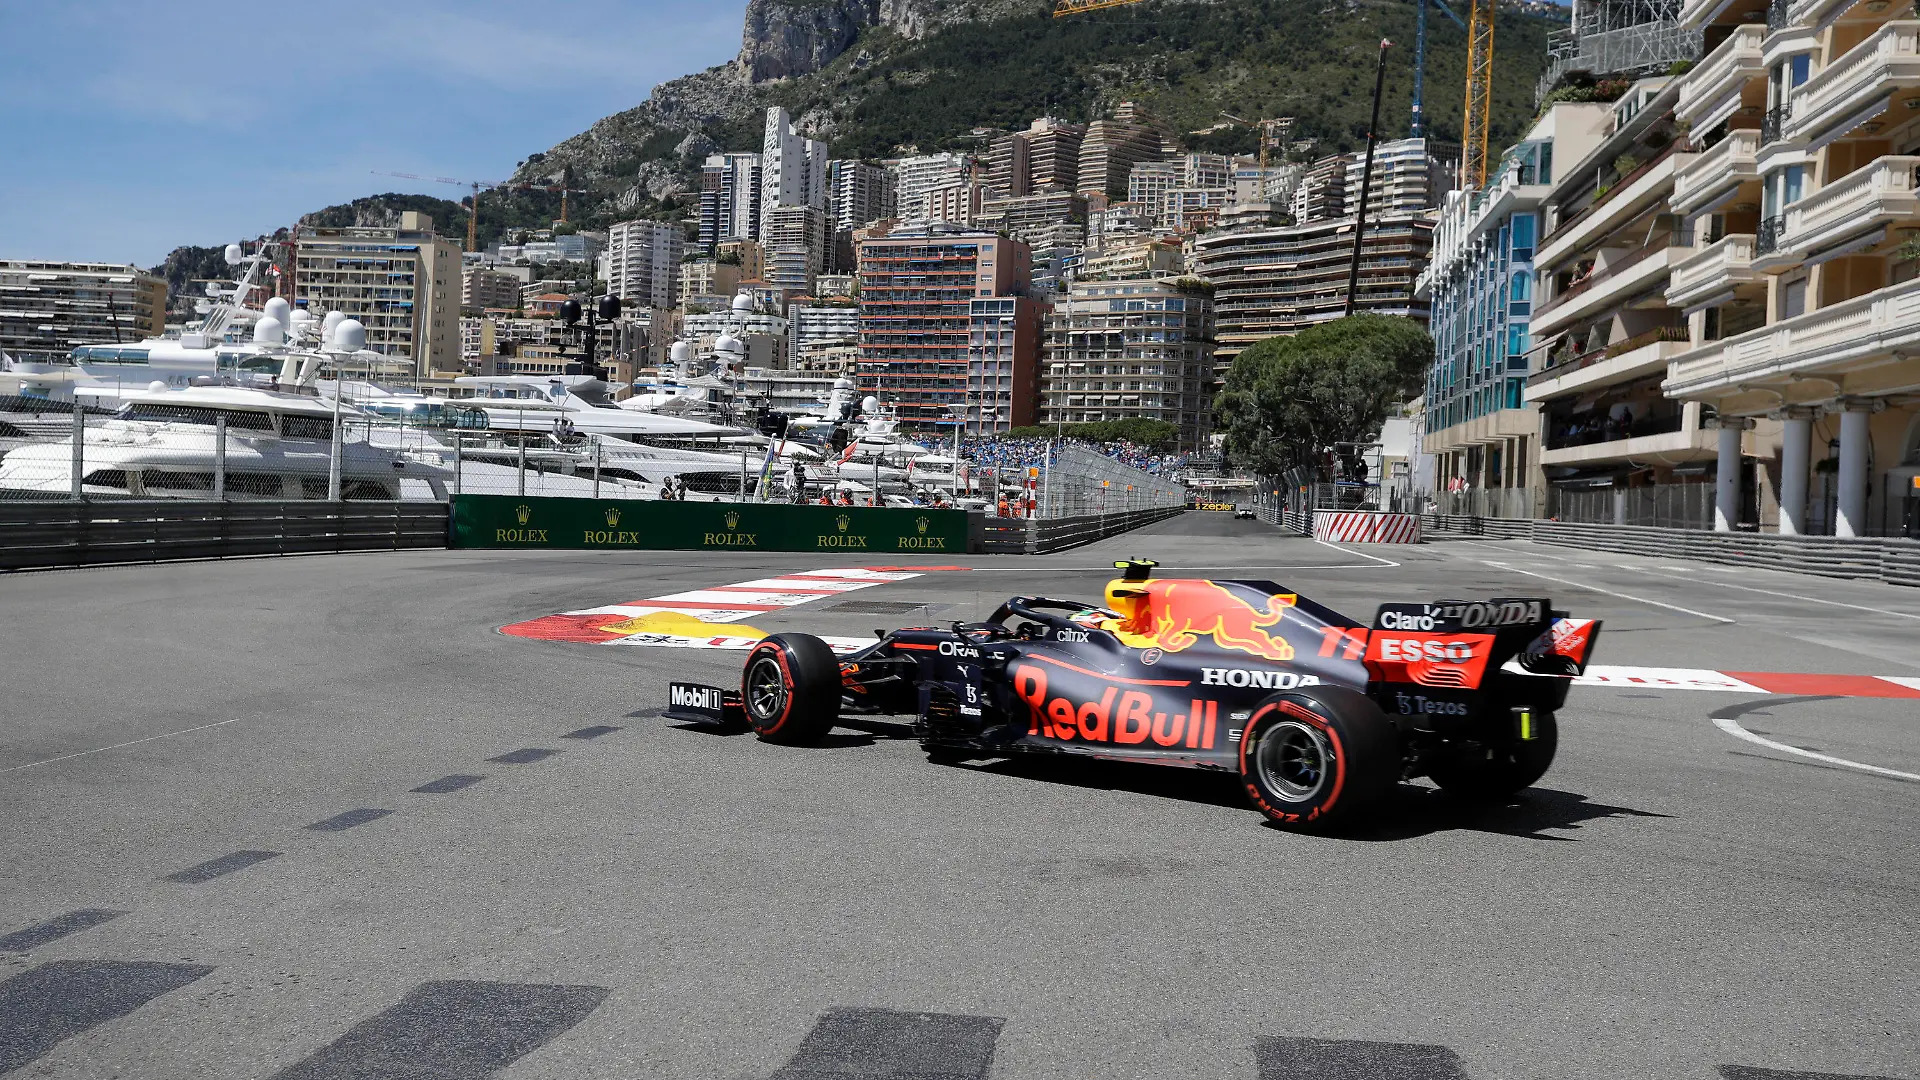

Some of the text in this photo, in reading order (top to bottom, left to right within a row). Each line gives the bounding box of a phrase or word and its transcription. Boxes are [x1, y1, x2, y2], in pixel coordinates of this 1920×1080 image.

[496, 529, 548, 542] ROLEX
[584, 530, 640, 544] ROLEX
[704, 532, 757, 546] ROLEX
[817, 535, 867, 547] ROLEX
[898, 537, 945, 548] ROLEX
[1380, 611, 1435, 631] Claro
[1443, 601, 1542, 627] HONDA
[1380, 638, 1473, 664] ESSO
[1200, 667, 1321, 690] HONDA
[671, 685, 710, 709] Mobil
[1416, 695, 1468, 716] Tezos
[960, 704, 982, 716] Tezos
[1246, 783, 1300, 823] ZERO
